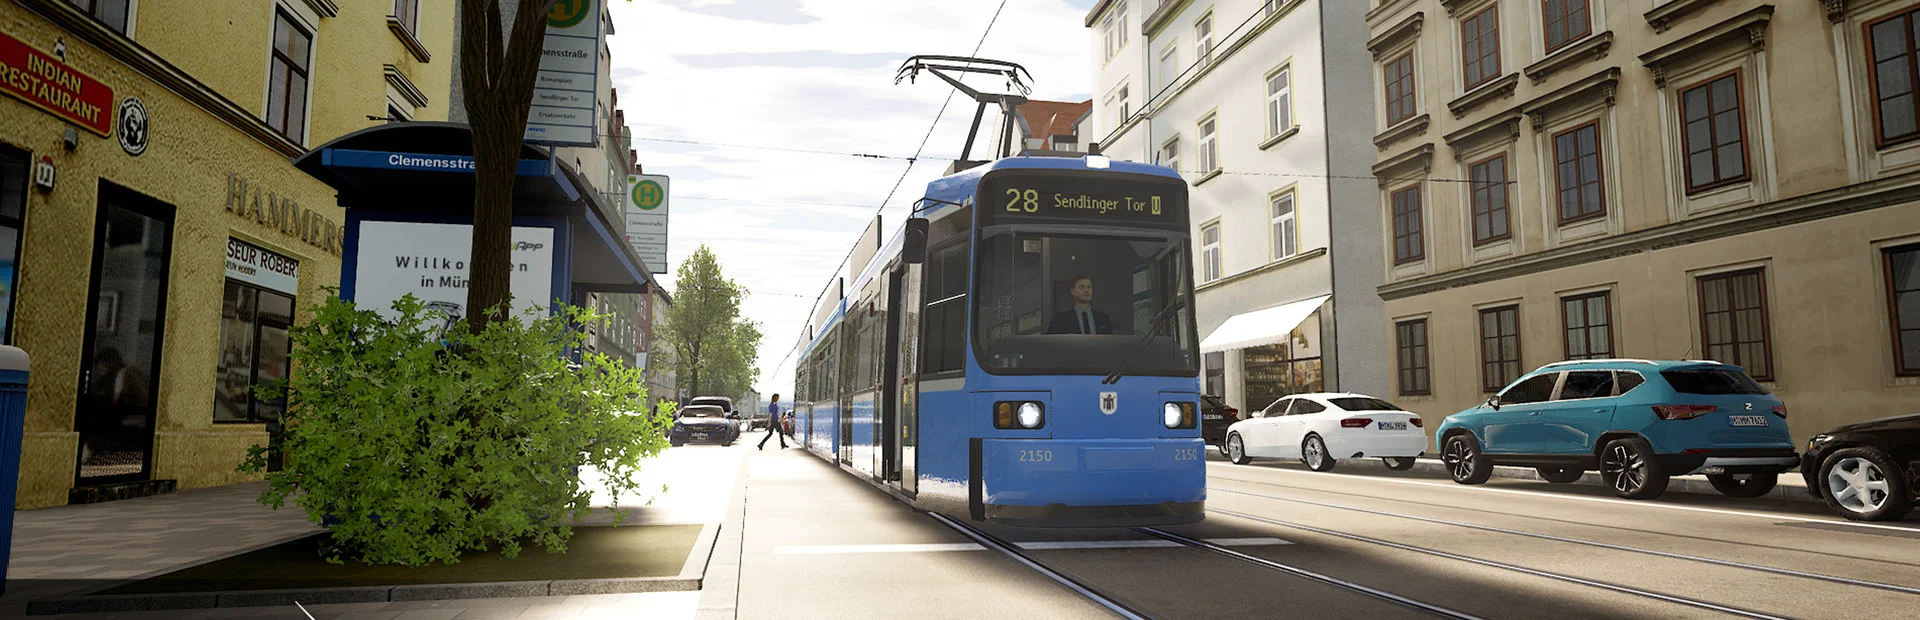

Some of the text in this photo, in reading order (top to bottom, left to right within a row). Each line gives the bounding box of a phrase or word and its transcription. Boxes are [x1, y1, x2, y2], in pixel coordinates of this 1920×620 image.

[542, 49, 588, 59] ensstraße
[27, 53, 82, 95] INDIAN
[0, 61, 101, 124] RESTAURANT
[388, 154, 476, 169] Clemensstra
[1006, 188, 1039, 213] 28
[1054, 193, 1119, 214] Sendlinger
[1125, 196, 1146, 212] Tor
[227, 240, 257, 266] SEUR
[421, 275, 434, 288] in
[1019, 450, 1053, 462] 2150
[1175, 448, 1198, 460] 2150
